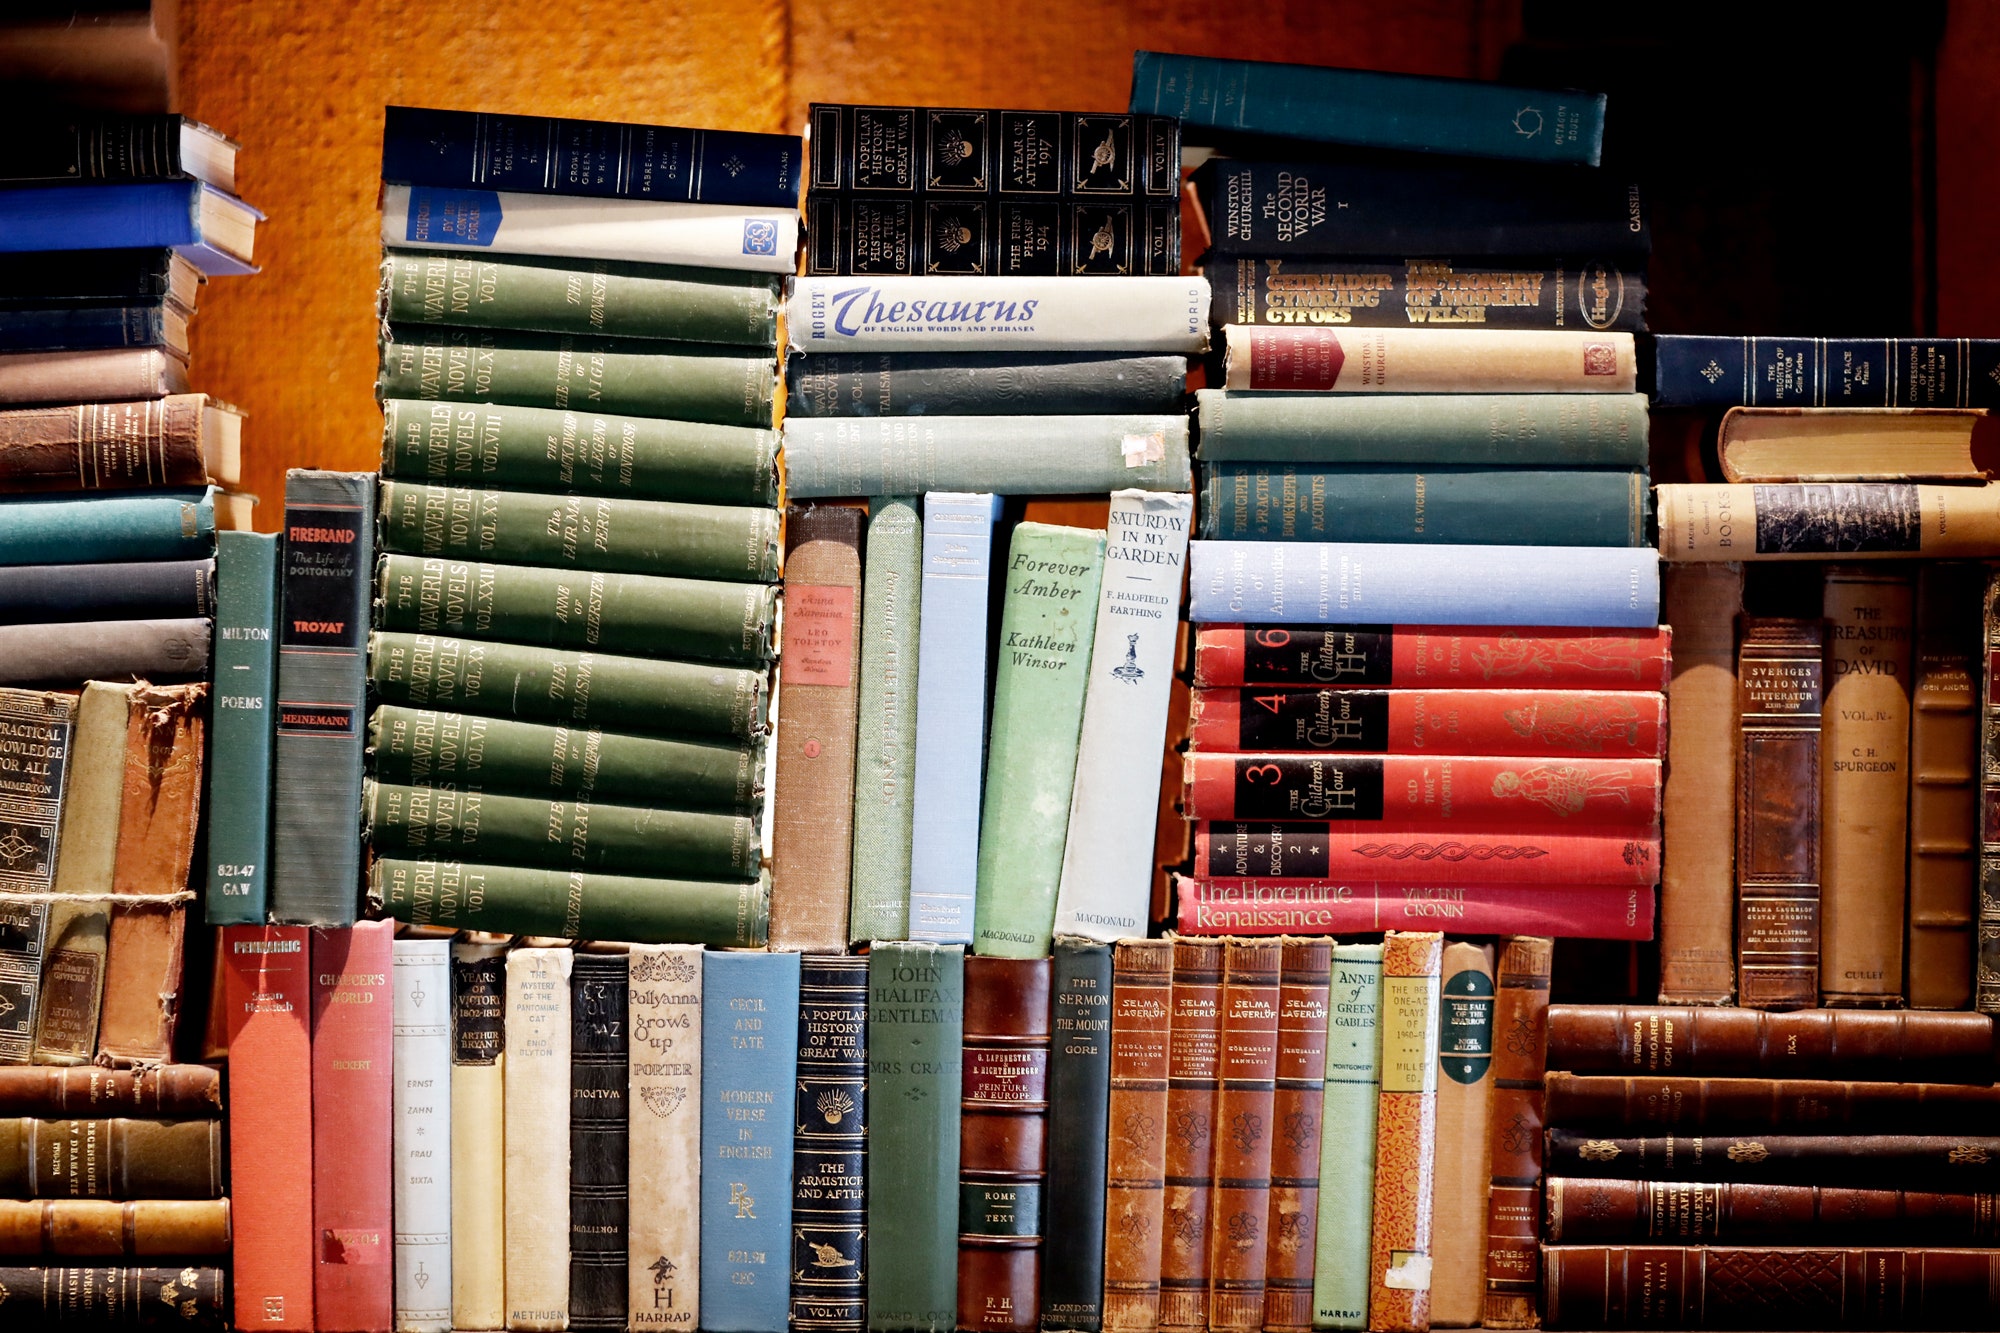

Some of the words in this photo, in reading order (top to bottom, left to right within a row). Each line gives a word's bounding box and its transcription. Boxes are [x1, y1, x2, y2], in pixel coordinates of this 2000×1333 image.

[898, 114, 907, 141] WAR
[1014, 121, 1023, 139] OF
[860, 114, 870, 172] POPULAR
[886, 127, 894, 152] THE
[872, 121, 883, 175] HISTORY
[1026, 120, 1035, 187] ATTRITION
[1039, 139, 1051, 165] 1917
[1156, 135, 1164, 171] VOL.IV
[886, 156, 894, 172] OF
[898, 146, 907, 184] GREAT
[1014, 142, 1024, 175] YEAR
[778, 151, 789, 190] ODHAMS
[860, 176, 867, 184] A
[1014, 176, 1022, 184] A
[1228, 175, 1239, 237] WINSTON
[1242, 170, 1252, 240] CHURCHILL
[1264, 193, 1275, 218] The
[1278, 172, 1292, 242] SECOND
[1295, 177, 1308, 237] WORLD
[1312, 186, 1325, 226] WAR
[1630, 183, 1642, 232] CASSELL
[1011, 209, 1020, 245] FIRST
[1024, 219, 1033, 257] PHASE
[1037, 226, 1049, 251] 1914
[1155, 226, 1163, 256] VOL.I
[1011, 250, 1020, 269] THE
[1266, 291, 1379, 308] CYMRAEG
[1406, 290, 1437, 306] OF
[1440, 291, 1540, 306] MODERN
[832, 287, 1038, 337] Thesaurus
[1189, 289, 1198, 333] WORLD
[1266, 307, 1352, 324] CYFOES
[1407, 307, 1486, 323] WELSH
[407, 422, 420, 455] THE
[428, 404, 451, 475] WAVERLEY
[455, 411, 475, 472] NOVELS
[483, 415, 501, 472] VOL.VIII
[619, 422, 636, 487] MONTROSE
[1311, 476, 1324, 531] ACCOUNTS
[594, 499, 611, 551] PERTH
[1110, 511, 1185, 531] SATURDAY
[1720, 491, 1731, 547] BOOKS
[290, 528, 355, 542] FIREBRAND
[1122, 531, 1137, 543] IN
[1145, 532, 1166, 544] MY
[295, 552, 311, 564] The
[315, 552, 334, 564] Life
[339, 552, 350, 564] of
[1107, 546, 1179, 565] GARDEN
[1011, 554, 1089, 577] Forever
[1014, 579, 1081, 599] Amber
[556, 585, 570, 623] ANNE
[1118, 593, 1168, 604] HADFIELD
[1110, 606, 1161, 619] FARTHING
[222, 627, 269, 640] MILTON
[294, 621, 344, 633] TROYAT
[1007, 632, 1075, 653] Kathleen
[1256, 629, 1290, 648] 6
[1012, 651, 1066, 670] Winsor
[1449, 636, 1460, 673] TODAY
[1752, 668, 1811, 676] SVERIGES
[1834, 660, 1897, 675] DAVID
[1745, 680, 1818, 689] NATIONAL
[221, 696, 262, 709] POEMS
[1254, 694, 1286, 714] 4
[1751, 692, 1812, 700] LITTERATUR
[282, 715, 348, 725] HEINEMANN
[1842, 710, 1873, 721] VOL.
[1853, 749, 1863, 758] C.
[1866, 749, 1878, 758] H.
[26, 760, 51, 775] ALL
[1246, 764, 1282, 785] 3
[1834, 761, 1896, 772] SPURGEON
[1301, 760, 1329, 817] Children's
[1324, 769, 1356, 817] Hour
[1290, 790, 1298, 810] THE
[572, 791, 590, 859] PIRATE
[1236, 823, 1246, 874] ADVENTURE
[1254, 845, 1264, 854] &
[1271, 824, 1282, 875] DISCOVERY
[1291, 846, 1300, 854] 2
[223, 884, 250, 895] GAW
[392, 869, 406, 902] THE
[439, 859, 461, 919] NOVELS
[1200, 881, 1239, 904] The
[1243, 882, 1352, 904] Florentine
[469, 874, 484, 914] VOL.I
[1402, 889, 1465, 902] VINCENT
[1197, 904, 1332, 927] Renaissance
[1404, 903, 1464, 918] CRONIN
[1625, 889, 1636, 927] COLLINS
[1075, 913, 1135, 927] MACDONALD
[981, 930, 1034, 943] MACDONALD
[320, 974, 384, 986] CHAUCER'S
[462, 972, 495, 984] YEARS
[892, 968, 942, 982] JOHN
[1340, 972, 1375, 985] ANNE
[1845, 971, 1884, 980] CULLEY
[472, 985, 485, 993] OF
[1073, 979, 1096, 988] THE
[330, 992, 373, 1004] WORLD
[1059, 994, 1108, 1005] SERMON
[1351, 987, 1362, 1002] of
[730, 998, 766, 1012] CECIL
[1123, 1000, 1160, 1008] SELMA
[1337, 1003, 1375, 1014] GREEN
[1118, 1008, 1166, 1018] LAGERLÖF
[634, 1016, 688, 1039] grows
[735, 1019, 762, 1031] AND
[1058, 1019, 1079, 1030] THE
[1082, 1018, 1108, 1030] MOUNT
[1335, 1017, 1375, 1028] GABLES
[462, 1031, 498, 1040] ARTHUR
[1665, 1020, 1673, 1046] BREF
[462, 1039, 499, 1049] BRYANT
[650, 1039, 672, 1053] up
[731, 1036, 764, 1049] TATE
[1066, 1046, 1097, 1054] GORE
[1634, 1021, 1642, 1064] SVENSKA
[407, 1080, 433, 1089] ERNST
[574, 1089, 620, 1098] WALPOLE
[408, 1106, 433, 1115] ZAHN
[410, 1150, 432, 1159] FRAU
[820, 1163, 844, 1173] THE
[798, 1189, 822, 1199] AND
[827, 1188, 865, 1199] AFTER
[985, 1192, 1016, 1200] ROME
[986, 1214, 1015, 1222] TEXT
[513, 1311, 564, 1321] METHUEN
[809, 1308, 849, 1318] VOL.VI
[1320, 1309, 1361, 1318] HARRAP
